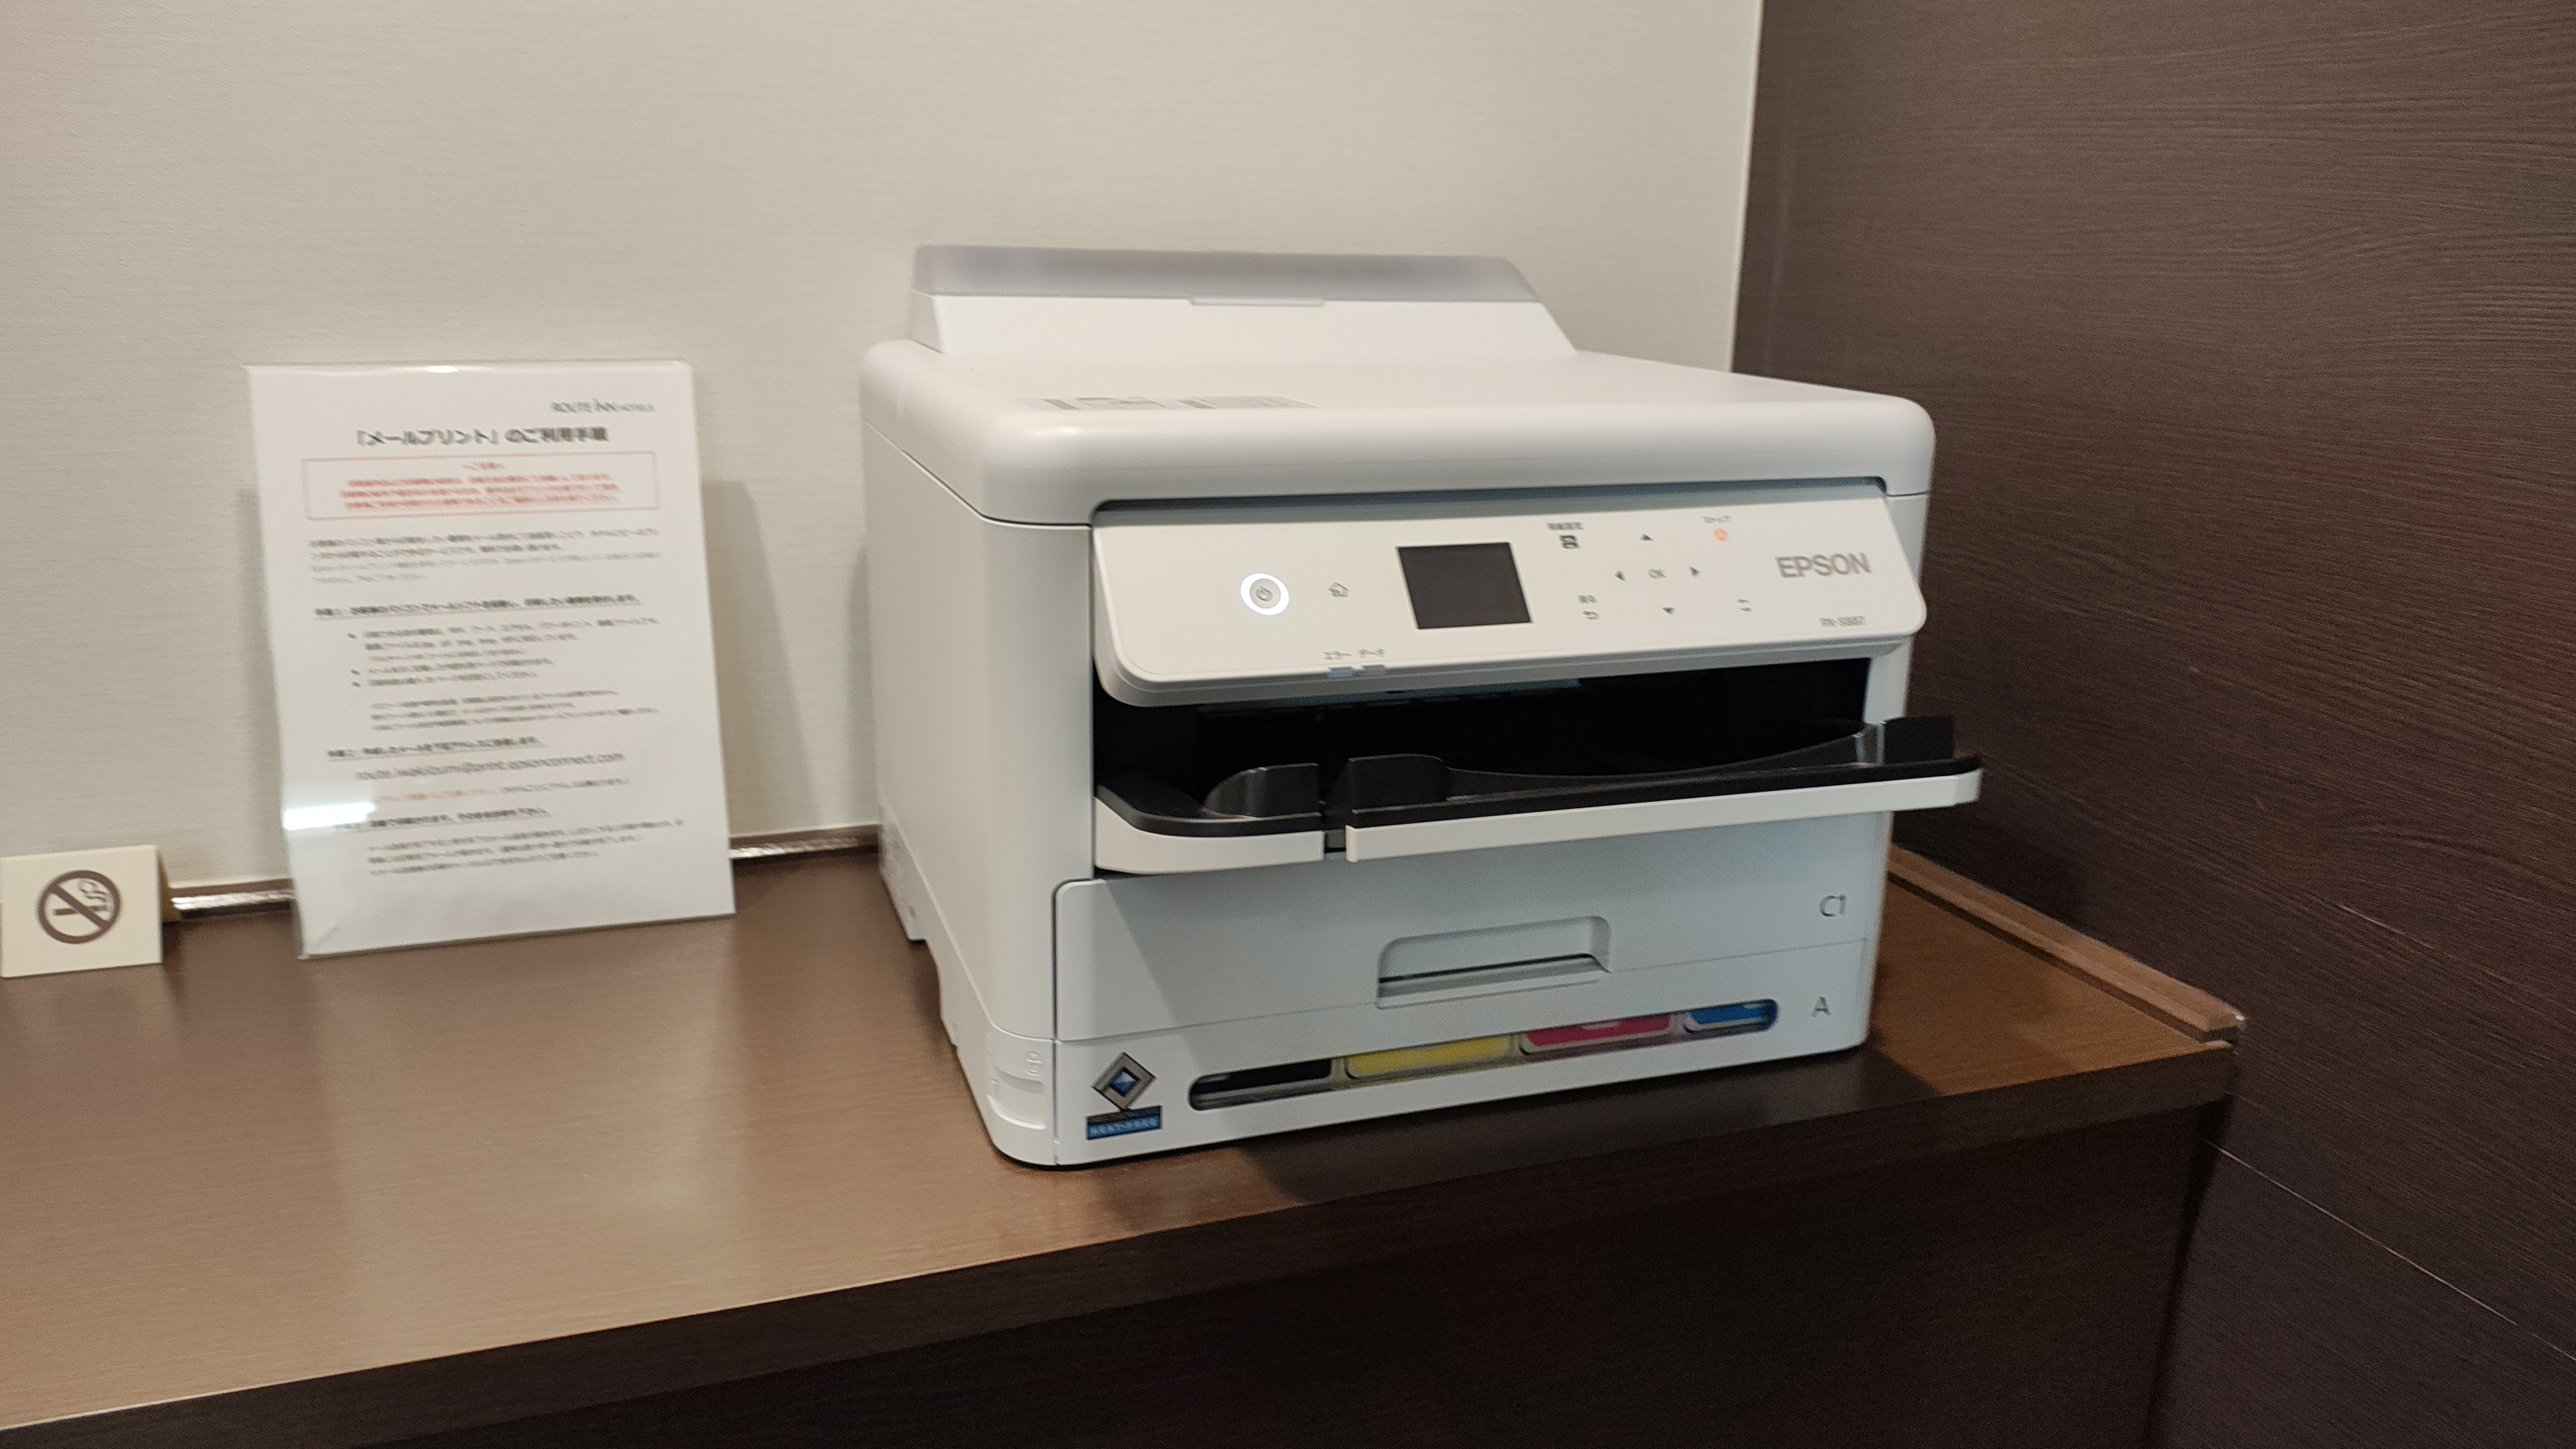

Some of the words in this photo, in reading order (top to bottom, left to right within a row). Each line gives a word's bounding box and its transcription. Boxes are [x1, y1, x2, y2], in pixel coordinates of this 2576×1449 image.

[1647, 568, 1668, 579] OK
[1776, 553, 1872, 577] EPSON
[1819, 894, 1846, 918] C1
[1811, 996, 1831, 1018] A
